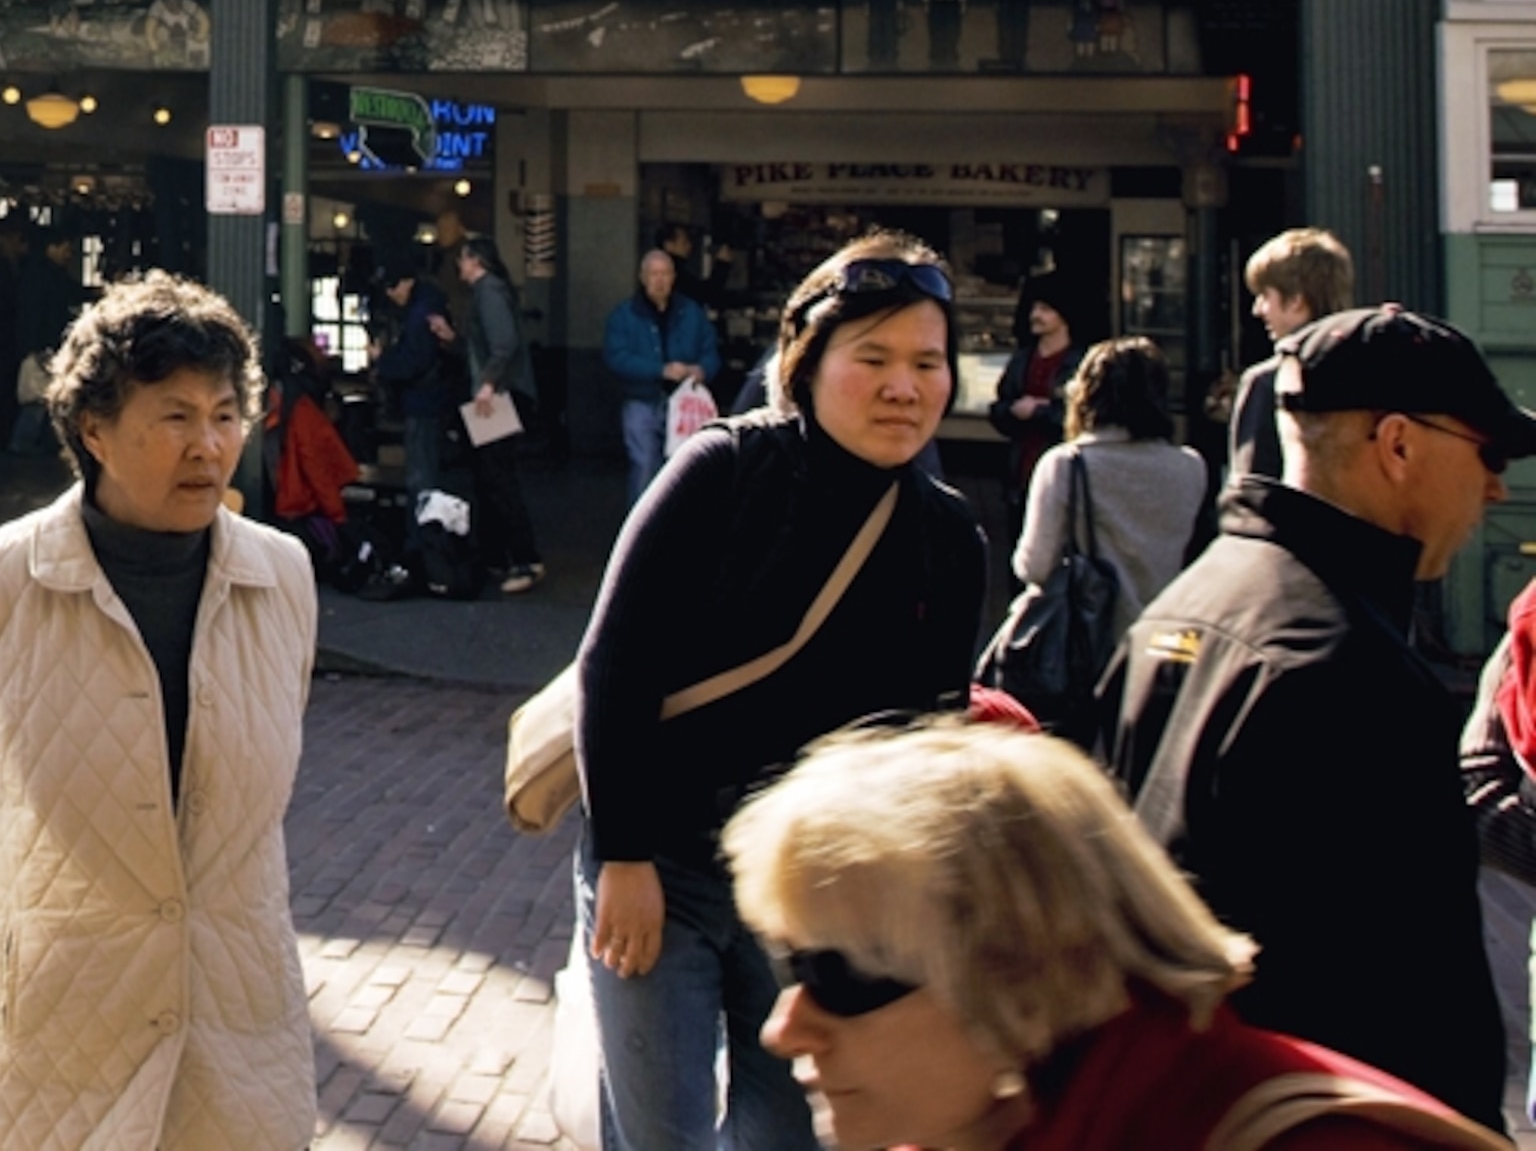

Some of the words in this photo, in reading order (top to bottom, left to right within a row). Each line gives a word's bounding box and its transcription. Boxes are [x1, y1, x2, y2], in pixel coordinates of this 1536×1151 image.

[735, 164, 813, 186] PIKE
[828, 164, 933, 183] PLACE
[951, 164, 1093, 190] BAKERY
